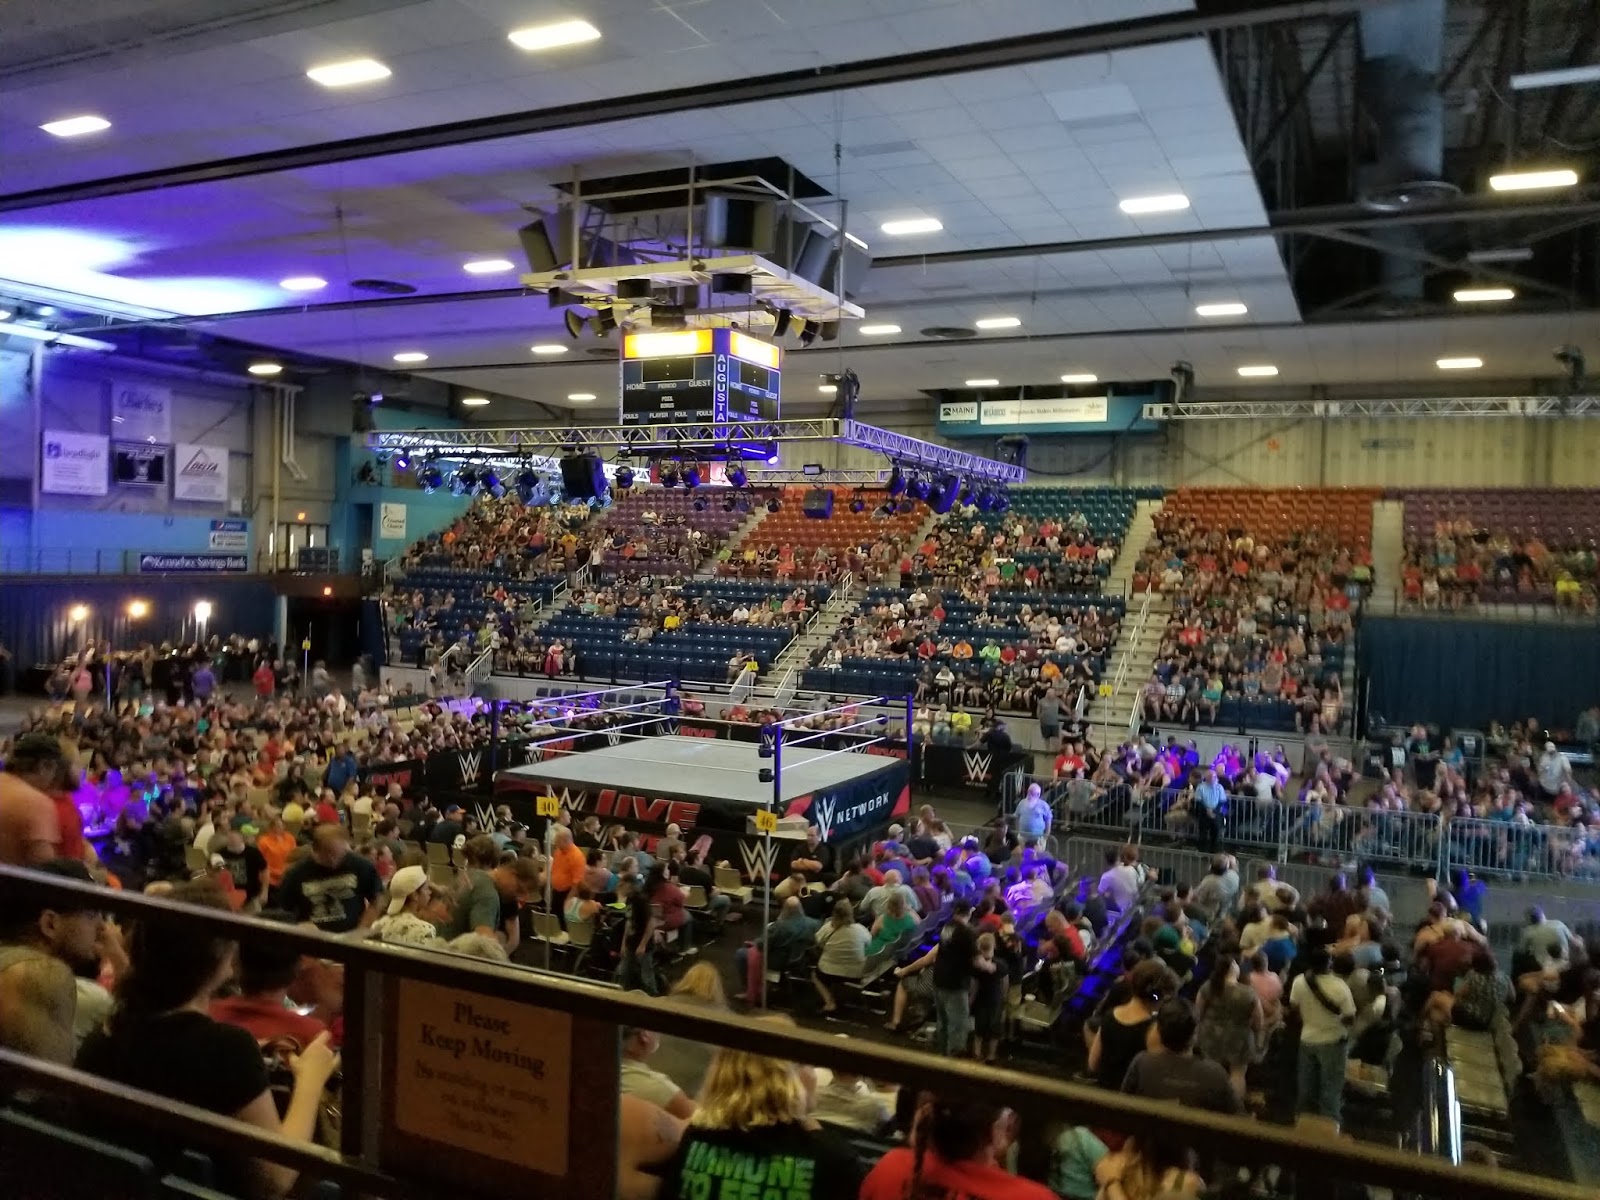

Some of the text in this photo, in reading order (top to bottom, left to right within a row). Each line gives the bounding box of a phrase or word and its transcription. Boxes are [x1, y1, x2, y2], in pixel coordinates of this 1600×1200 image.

[626, 383, 646, 391] HOME
[688, 379, 712, 387] GUEST
[717, 354, 726, 421] AUGUSTA
[951, 406, 975, 415] MAINE
[191, 462, 219, 472] DELTA
[197, 556, 226, 570] Savings
[594, 789, 701, 830] LIVE
[837, 792, 889, 824] NETWORK
[453, 1001, 512, 1036] Please
[419, 1023, 546, 1081] Keep Moving
[684, 1140, 816, 1190] IMMUNE
[680, 1168, 712, 1200] TO
